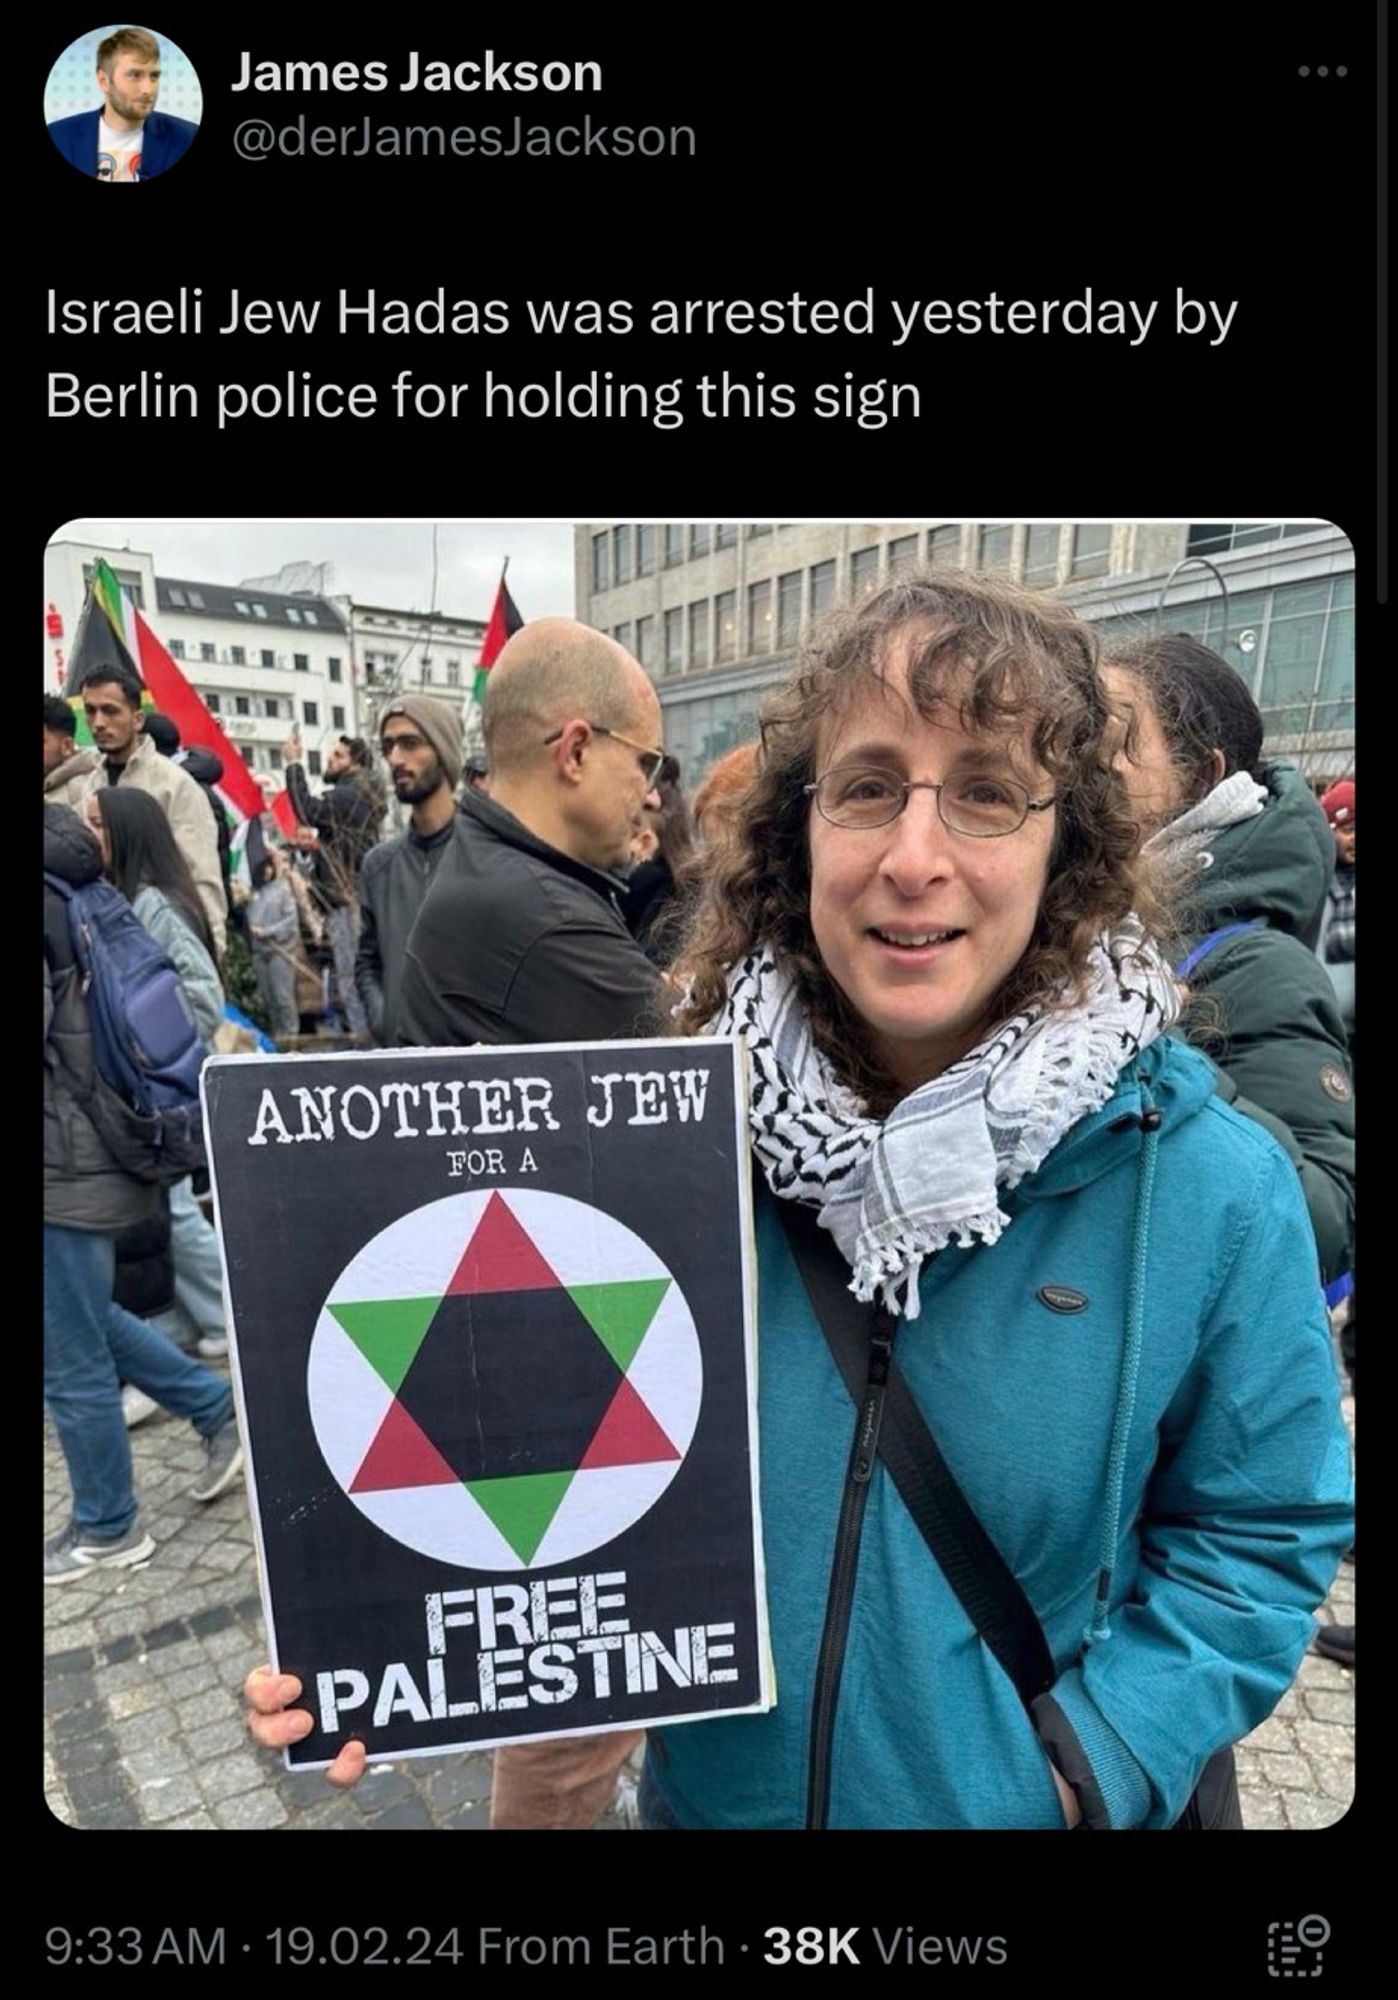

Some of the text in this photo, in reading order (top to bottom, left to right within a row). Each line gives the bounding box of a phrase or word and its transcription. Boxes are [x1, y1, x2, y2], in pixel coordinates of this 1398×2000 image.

[247, 1068, 710, 1145] ANOTHER JEW
[446, 1147, 538, 1176] FOR A
[425, 1571, 630, 1655] FREE
[316, 1622, 739, 1734] PALESTINE
